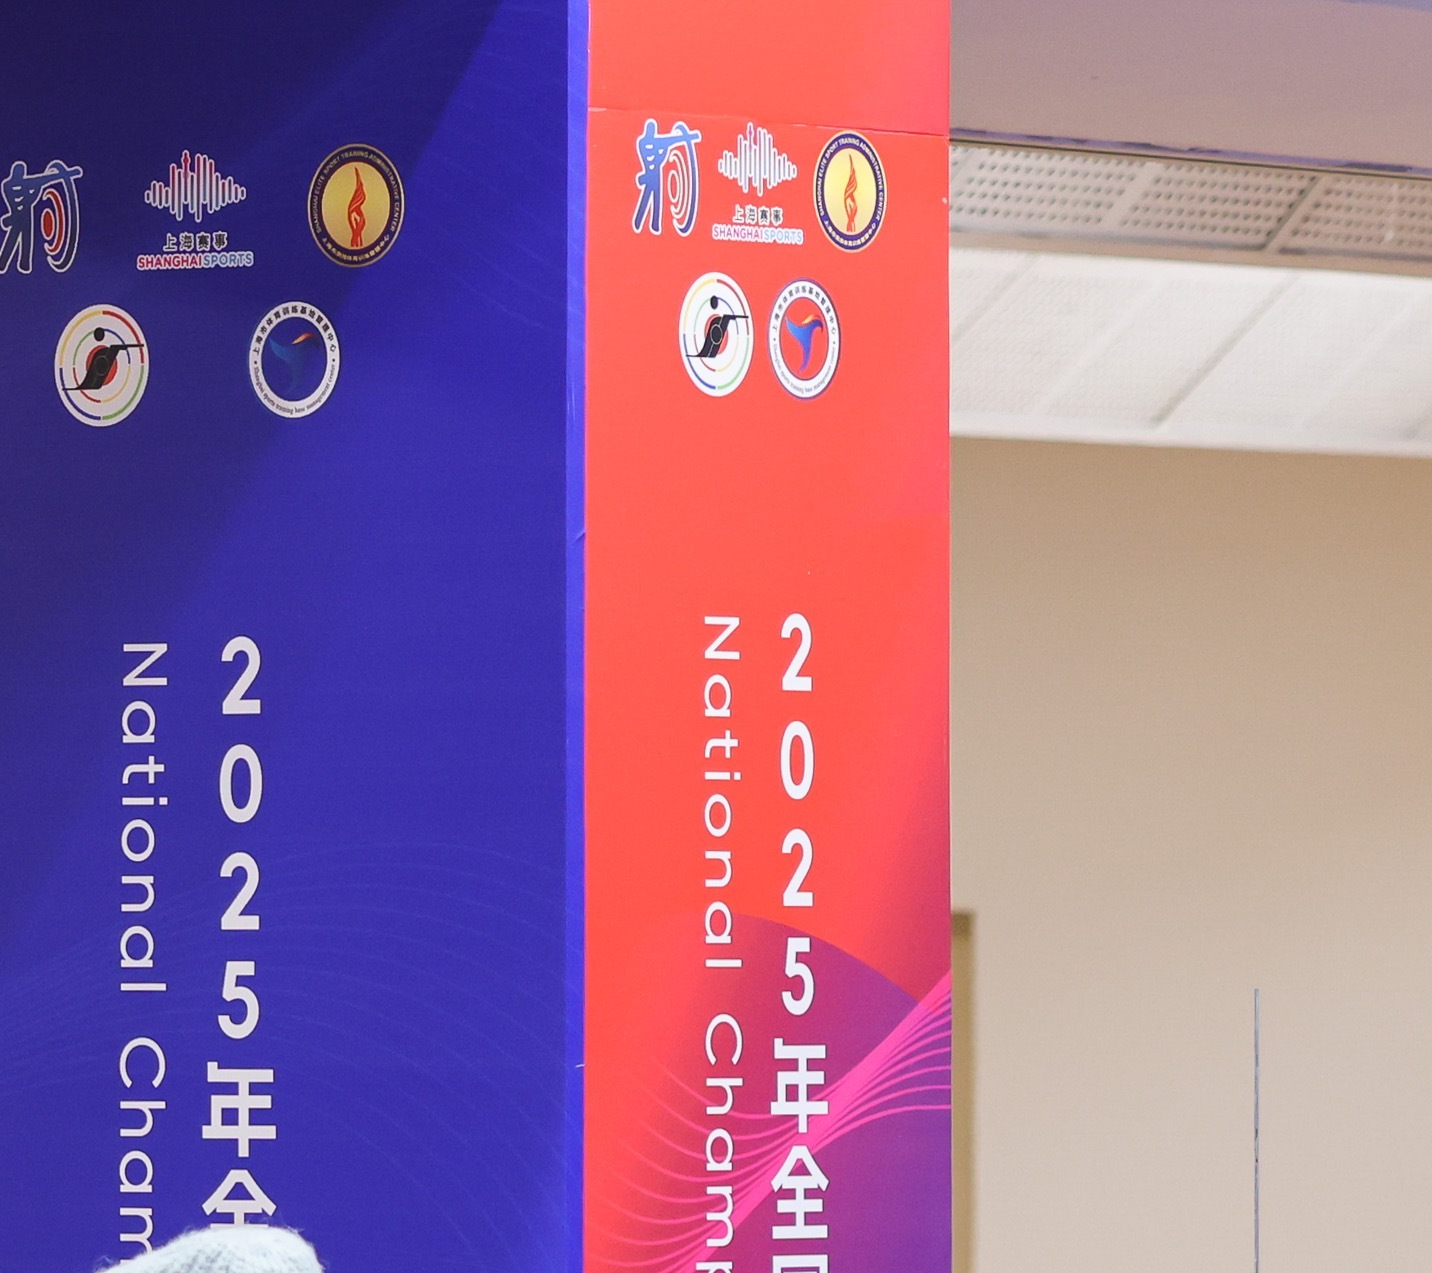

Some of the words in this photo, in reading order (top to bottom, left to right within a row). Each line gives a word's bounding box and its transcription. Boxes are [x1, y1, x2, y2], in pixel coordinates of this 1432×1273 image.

[163, 231, 228, 251] 上海赛事
[712, 224, 804, 245] SHANGHAISPORTS
[137, 251, 254, 271] SHANGHAISPORTS
[703, 616, 743, 968] National
[120, 643, 168, 993] National
